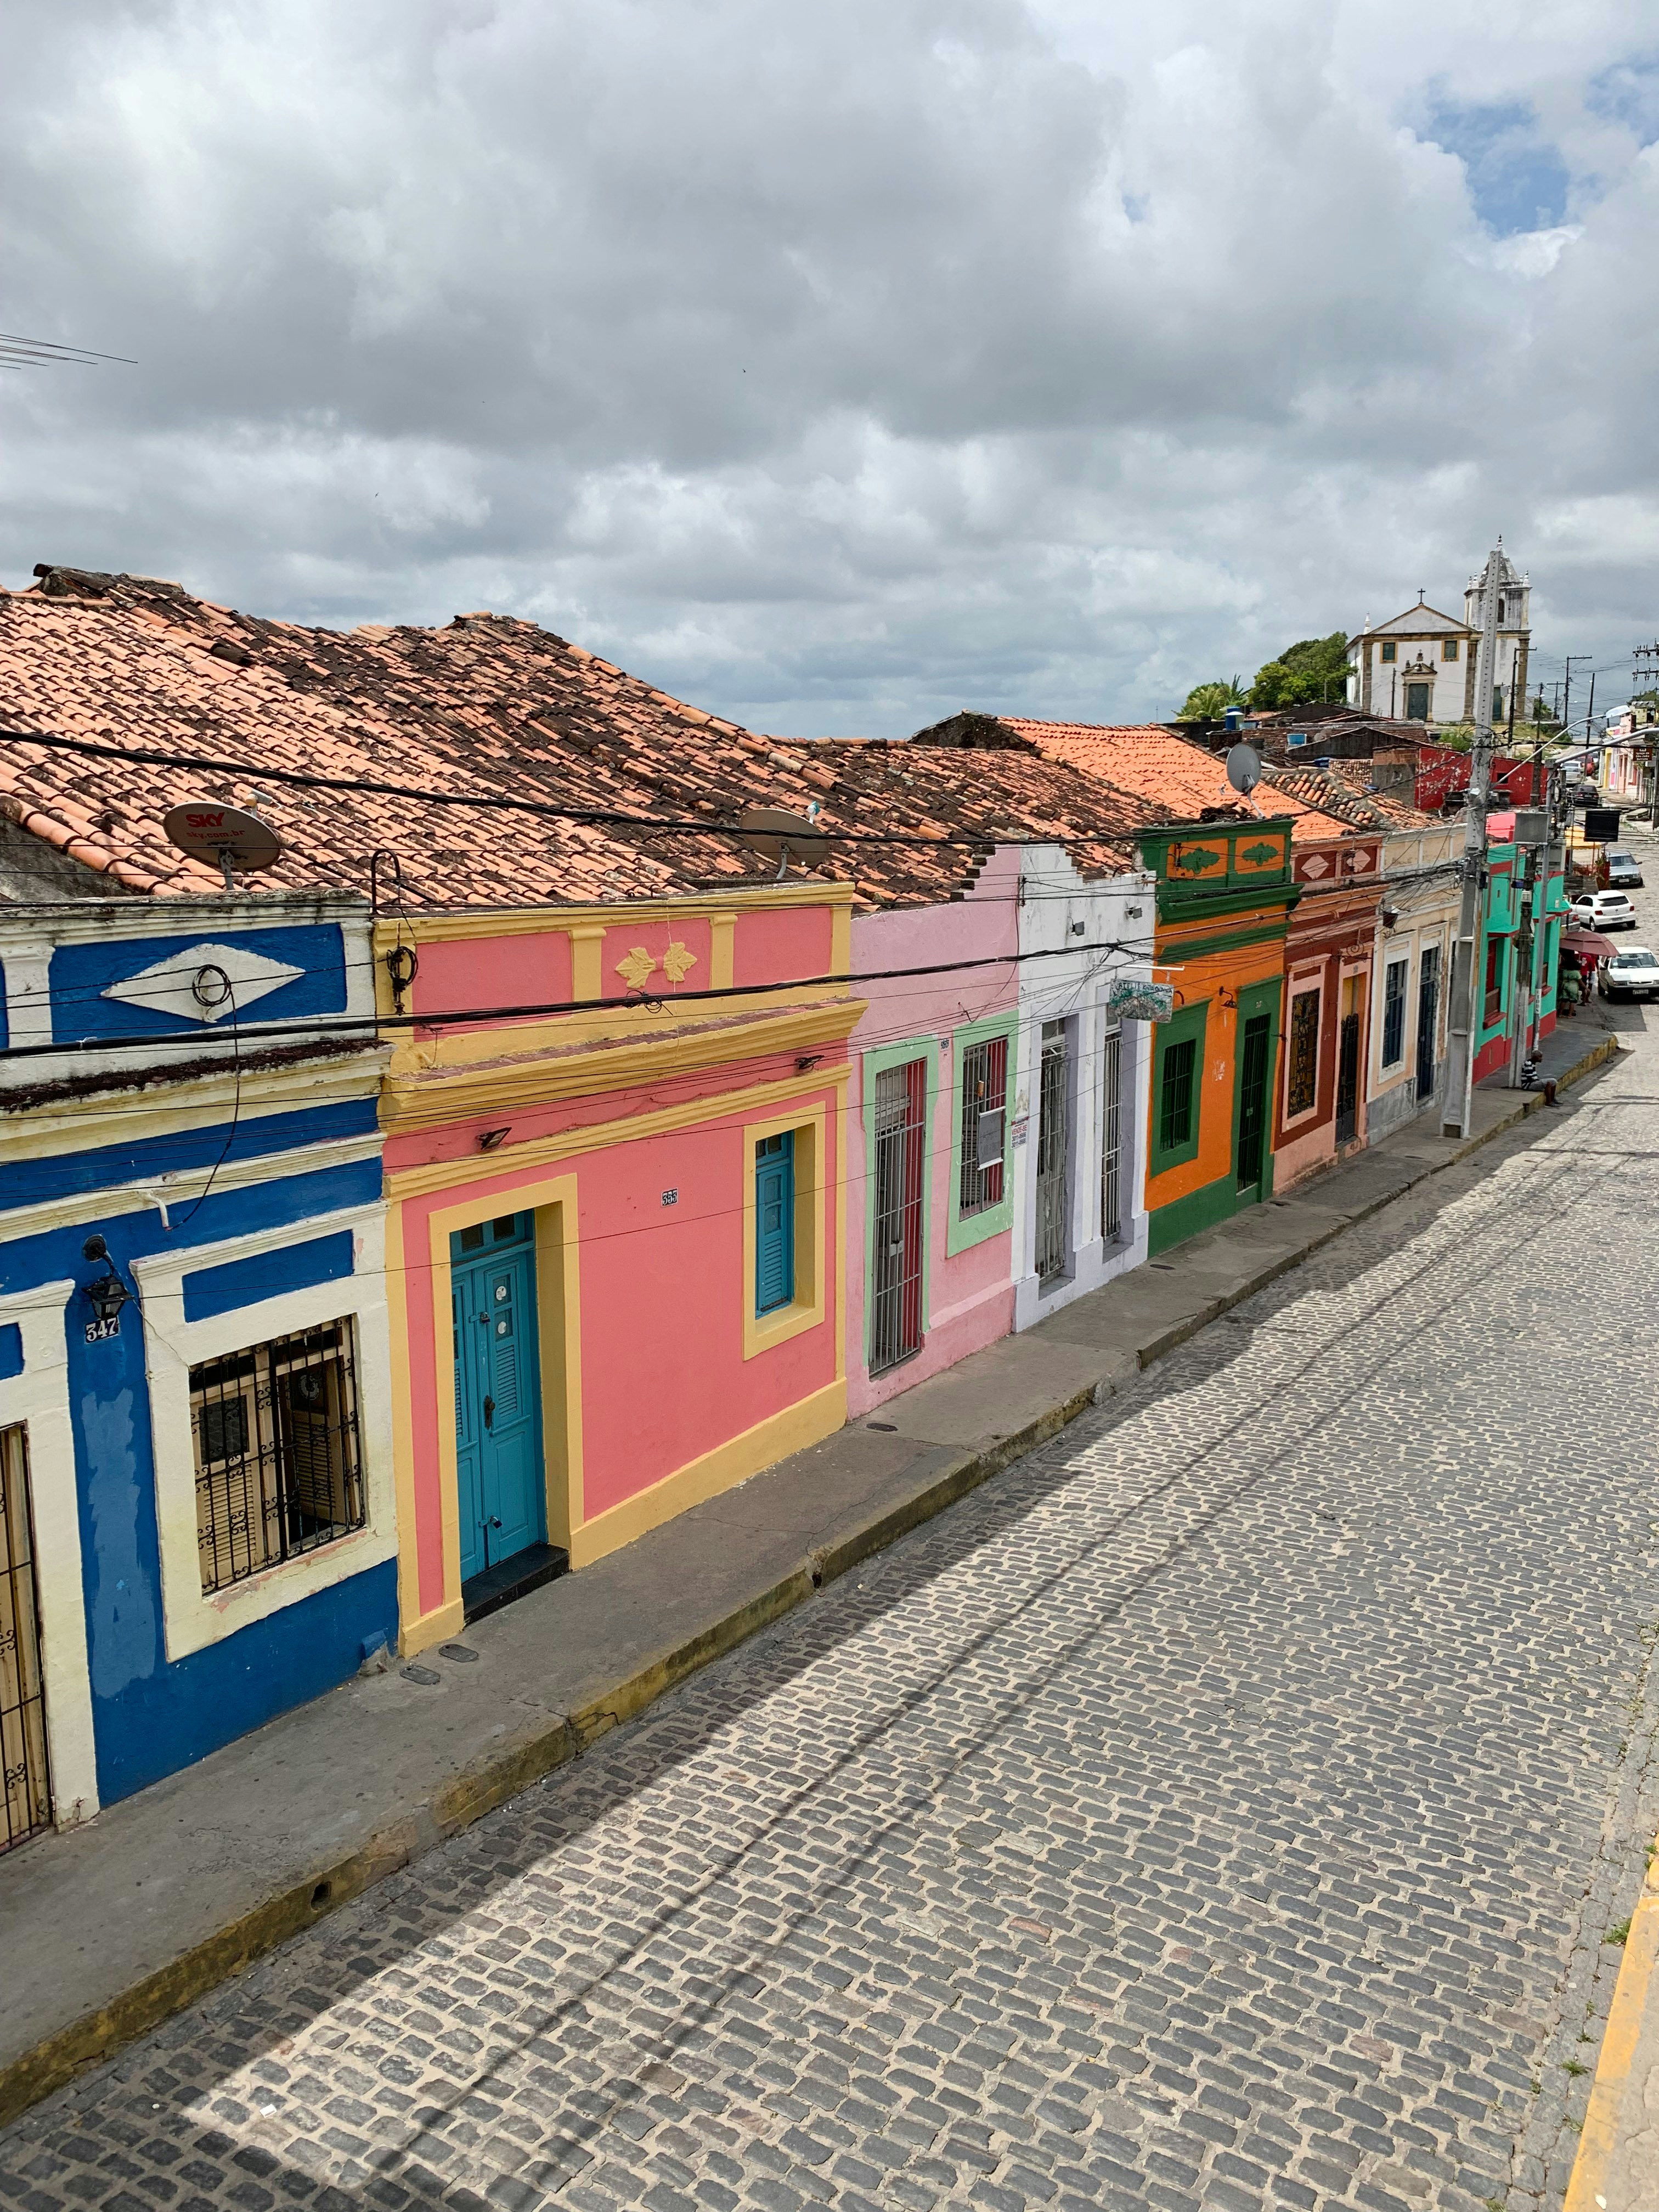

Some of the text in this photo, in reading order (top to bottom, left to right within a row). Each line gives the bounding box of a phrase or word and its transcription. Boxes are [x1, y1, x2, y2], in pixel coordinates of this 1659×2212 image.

[186, 812, 224, 828] SKY
[187, 830, 245, 839] sky.com.br
[86, 1317, 116, 1341] 347
